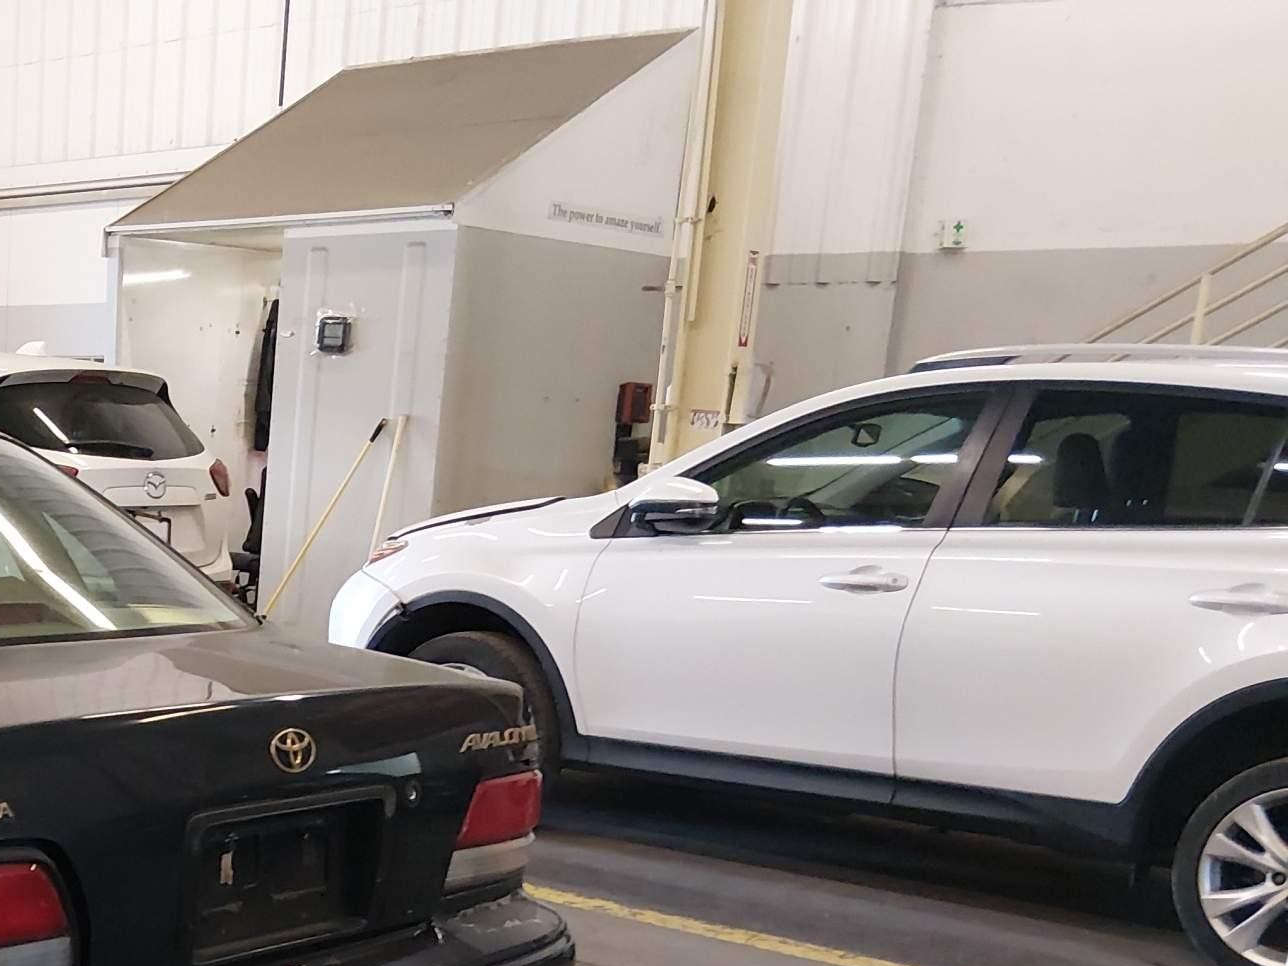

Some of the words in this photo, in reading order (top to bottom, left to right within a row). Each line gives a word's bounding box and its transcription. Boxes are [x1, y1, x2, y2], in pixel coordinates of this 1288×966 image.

[552, 203, 568, 218] The
[568, 209, 594, 224] power
[595, 212, 604, 224] to
[604, 215, 629, 229] amaze
